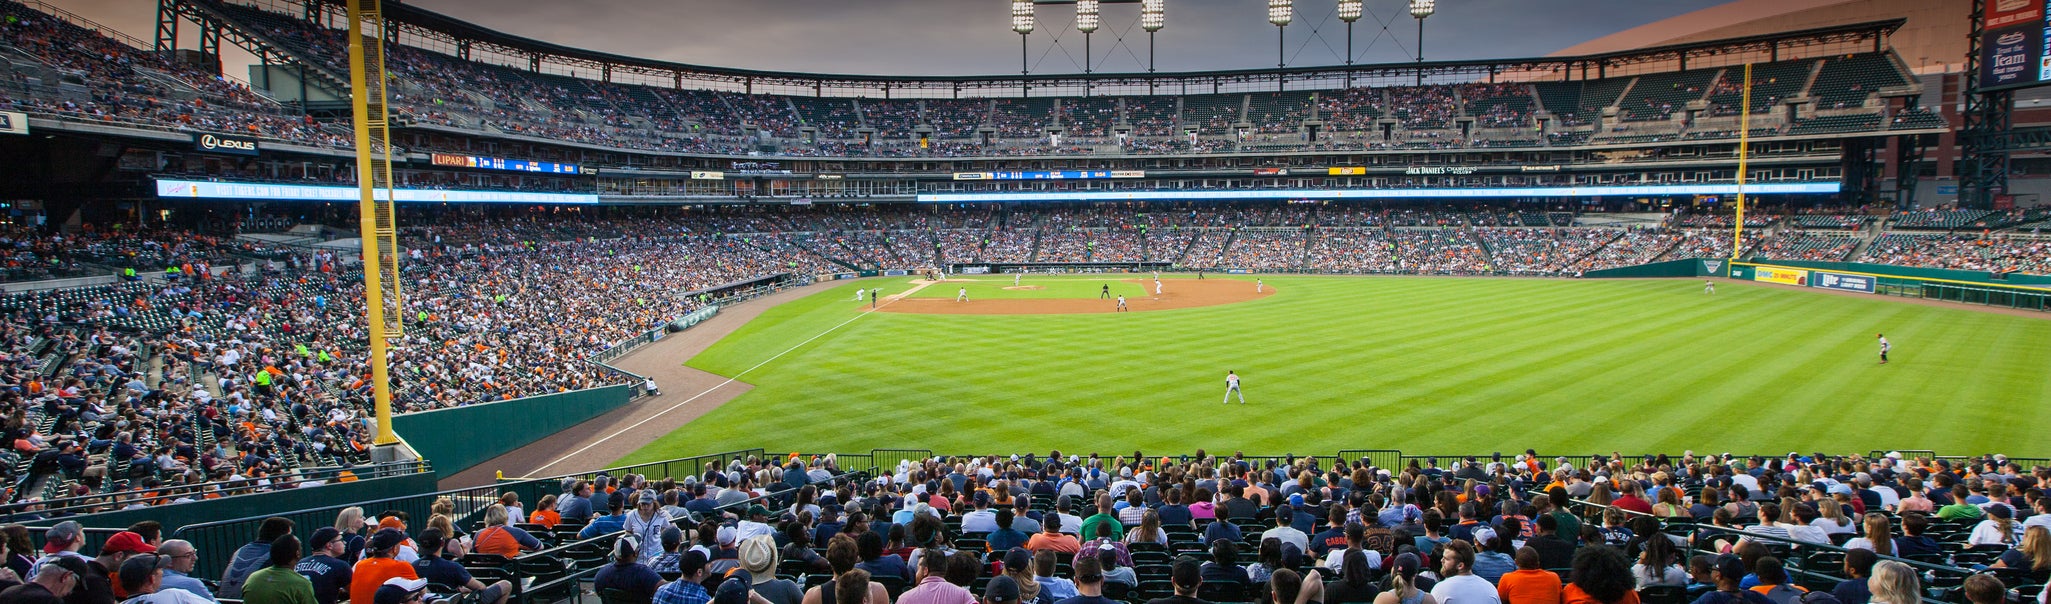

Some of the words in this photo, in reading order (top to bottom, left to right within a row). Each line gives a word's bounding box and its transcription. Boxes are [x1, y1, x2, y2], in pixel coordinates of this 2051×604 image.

[1992, 54, 2026, 68] Team
[217, 139, 255, 150] LEXUS
[437, 155, 464, 166] LIPARI
[1406, 166, 1420, 175] JACK
[1421, 166, 1445, 174] DANIEL'S
